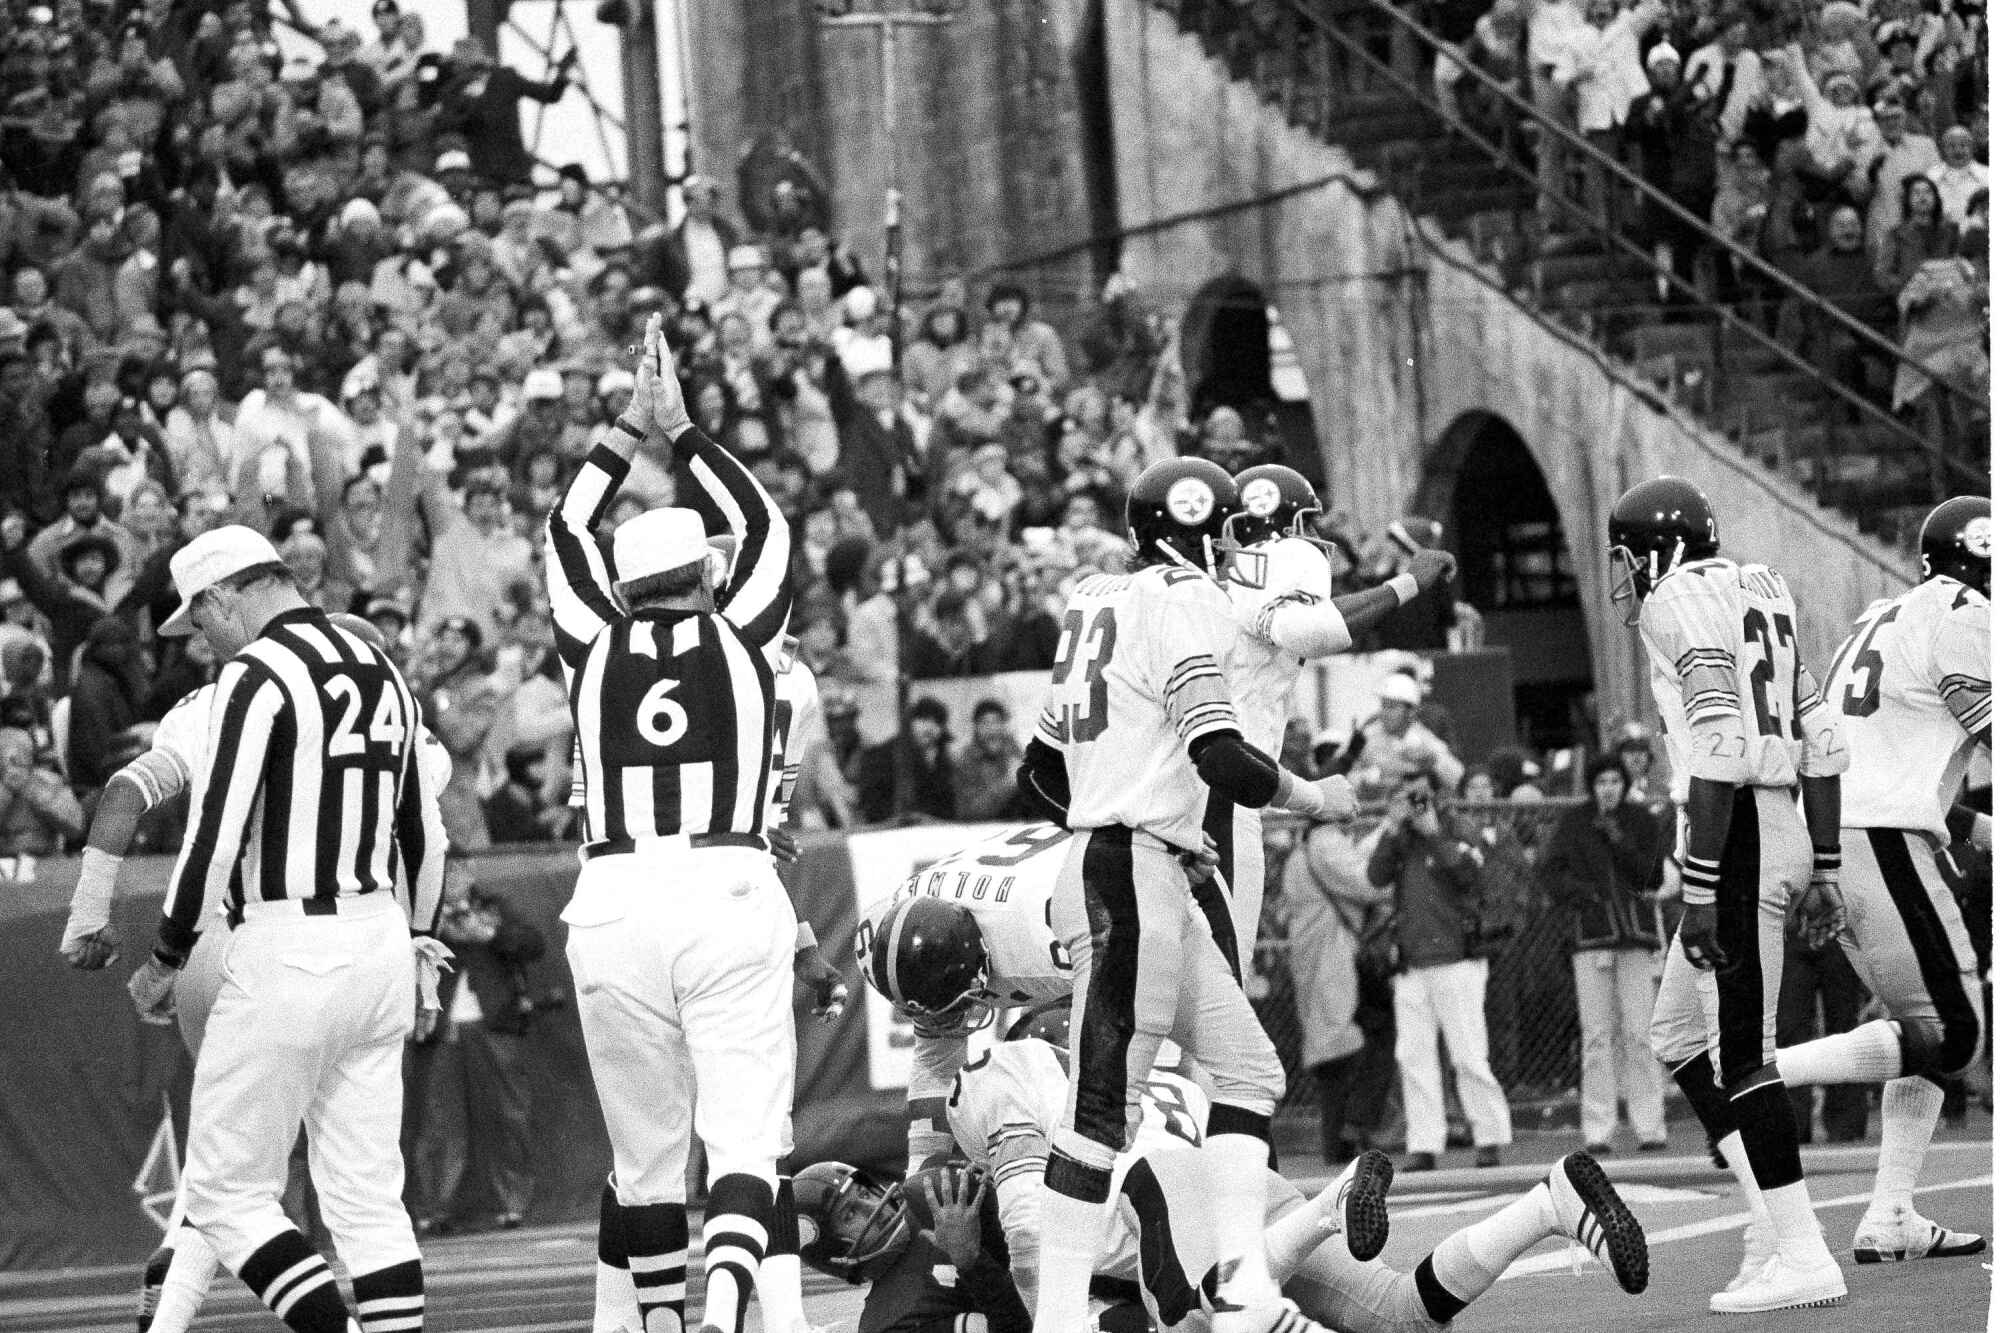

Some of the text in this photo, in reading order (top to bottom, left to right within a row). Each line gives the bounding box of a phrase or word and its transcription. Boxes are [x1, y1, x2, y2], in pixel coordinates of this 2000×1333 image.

[323, 673, 405, 758] 24
[636, 678, 688, 747] 6
[1052, 607, 1117, 744] 23
[1743, 607, 1803, 741] 27
[1709, 732, 1746, 759] 27
